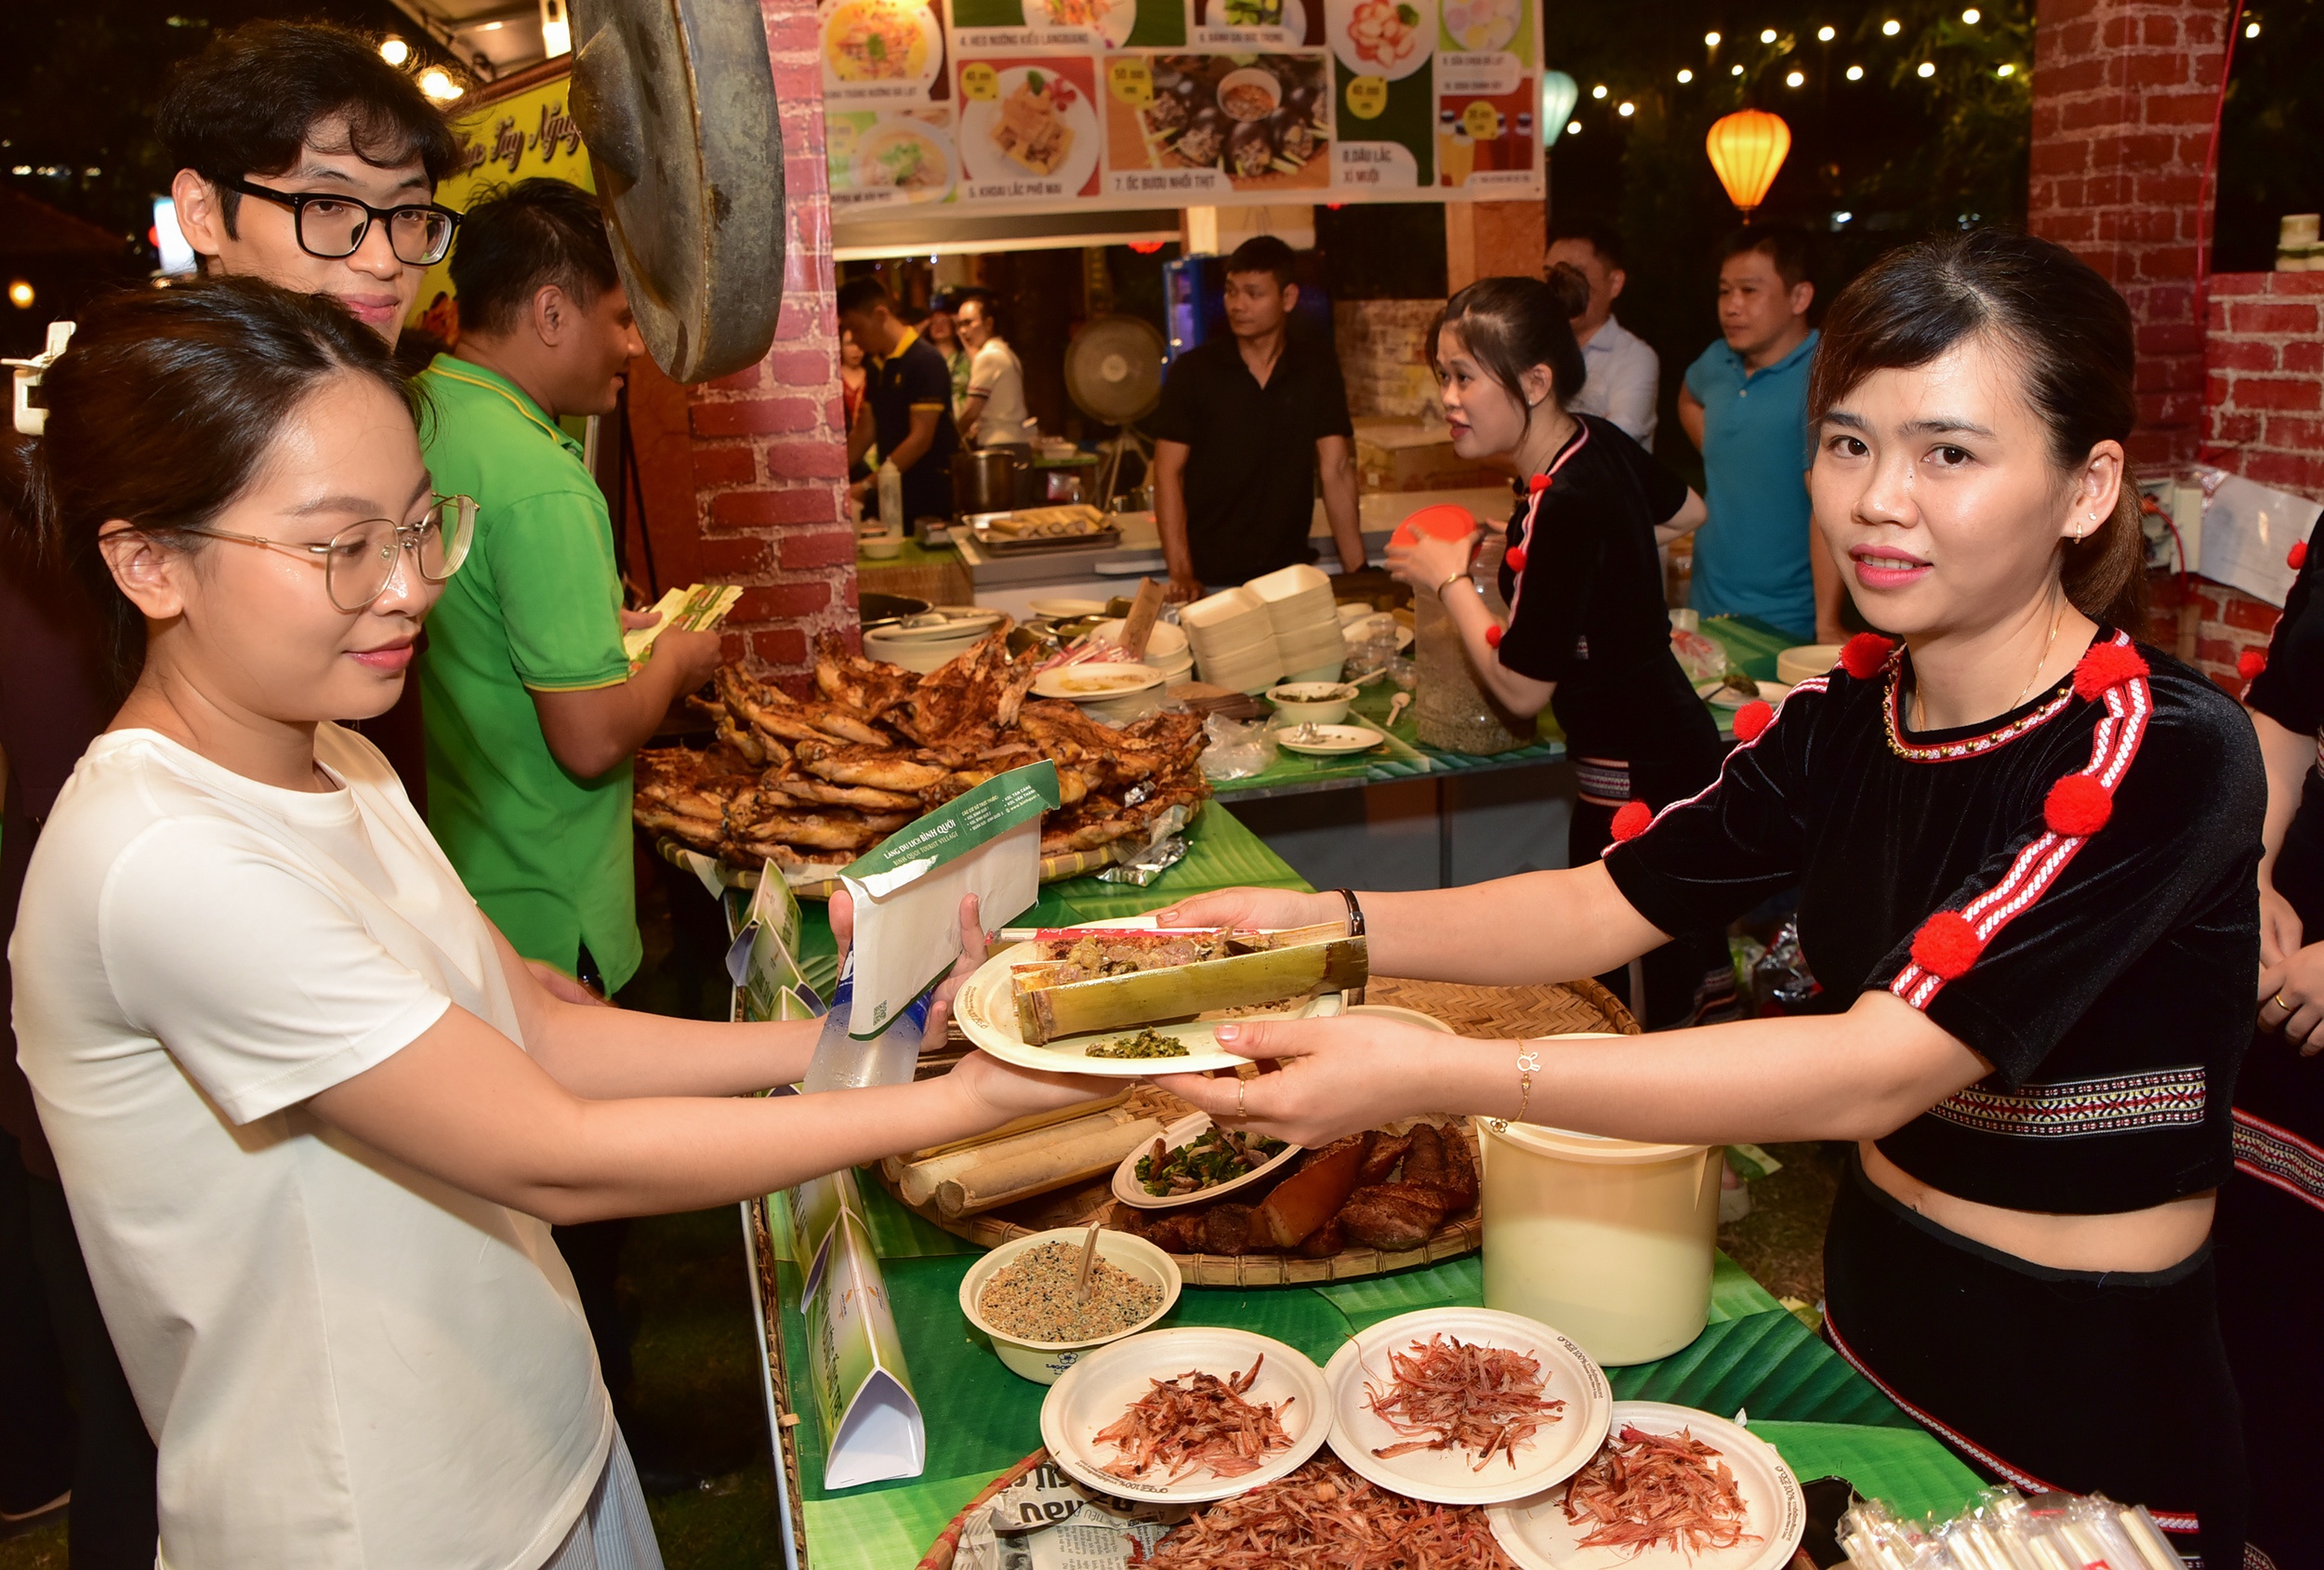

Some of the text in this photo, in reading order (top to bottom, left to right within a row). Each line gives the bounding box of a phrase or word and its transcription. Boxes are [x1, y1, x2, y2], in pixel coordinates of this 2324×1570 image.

[899, 842, 910, 852] DU
[919, 828, 938, 842] BÌNH
[919, 840, 939, 853] TOURIST
[938, 830, 958, 845] VILLAGE
